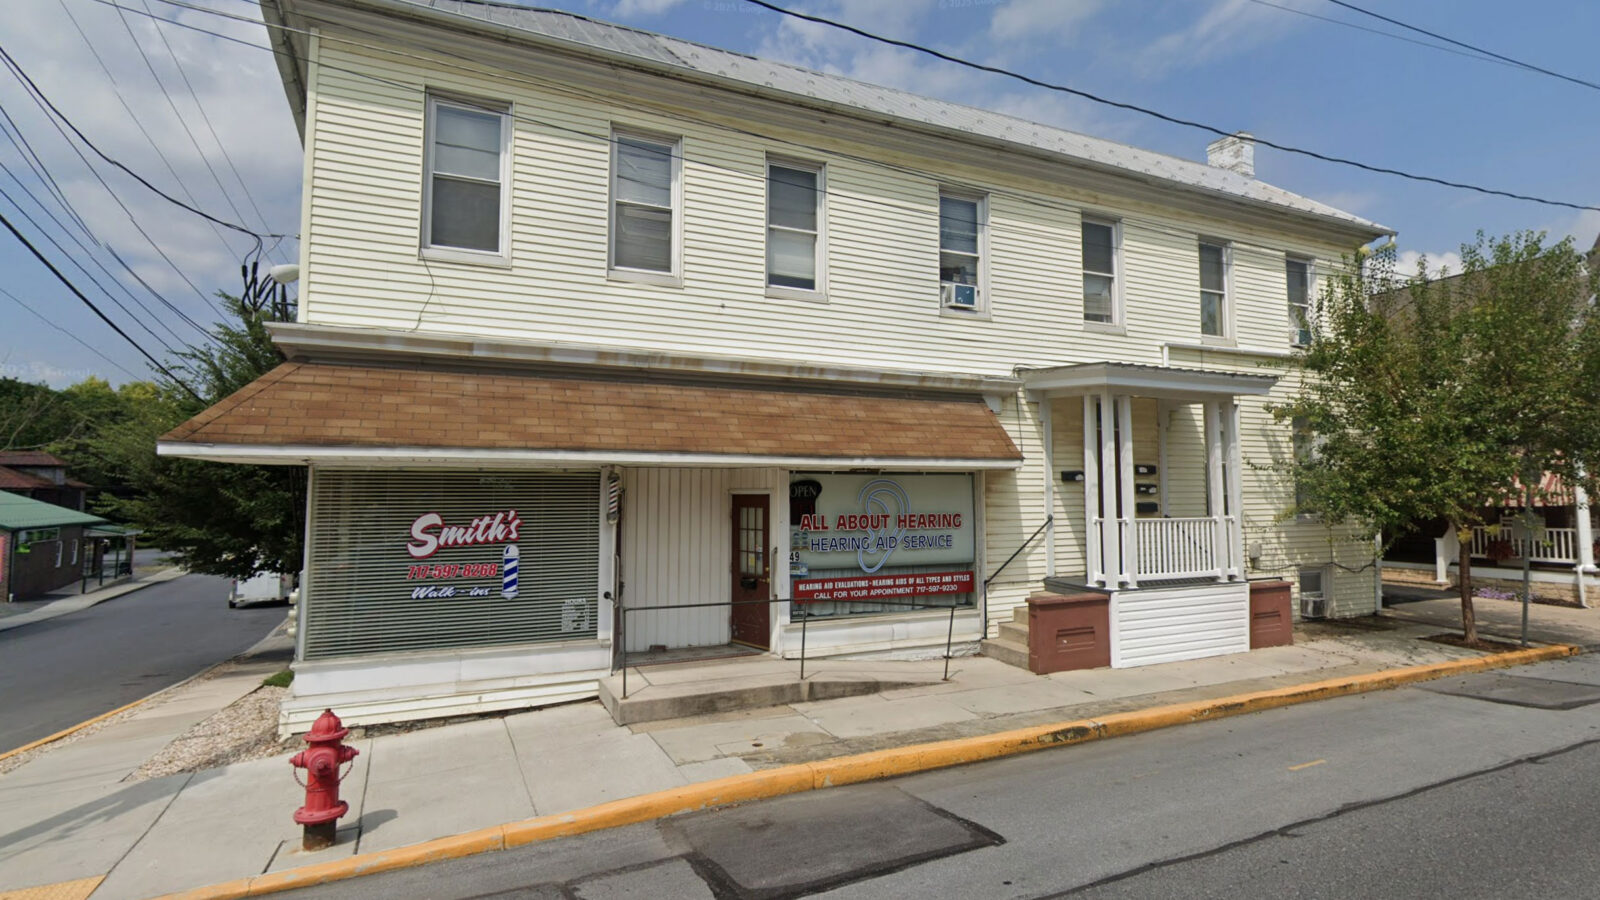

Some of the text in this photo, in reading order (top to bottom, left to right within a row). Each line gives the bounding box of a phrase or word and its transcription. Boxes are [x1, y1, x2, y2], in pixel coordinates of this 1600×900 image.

[790, 485, 817, 497] OPEN
[800, 512, 962, 531] ALL ABOUT HEARING
[406, 508, 524, 559] Smith's
[811, 536, 870, 552] HEARING
[876, 536, 898, 549] AID
[903, 534, 953, 549] SERVICE
[406, 563, 498, 579] 717-597-8268
[798, 583, 823, 591] HEARING
[824, 582, 834, 590] AID
[835, 580, 869, 589] EVALUATIONS
[872, 578, 894, 586] HEARING
[896, 577, 907, 585] AIDS
[908, 577, 915, 585] OF
[942, 575, 952, 583] AND
[953, 574, 970, 582] STYLES
[411, 585, 455, 599] Walk
[469, 587, 491, 597] ins
[849, 589, 868, 597] YOUR
[869, 587, 913, 596] APPOINTMENT
